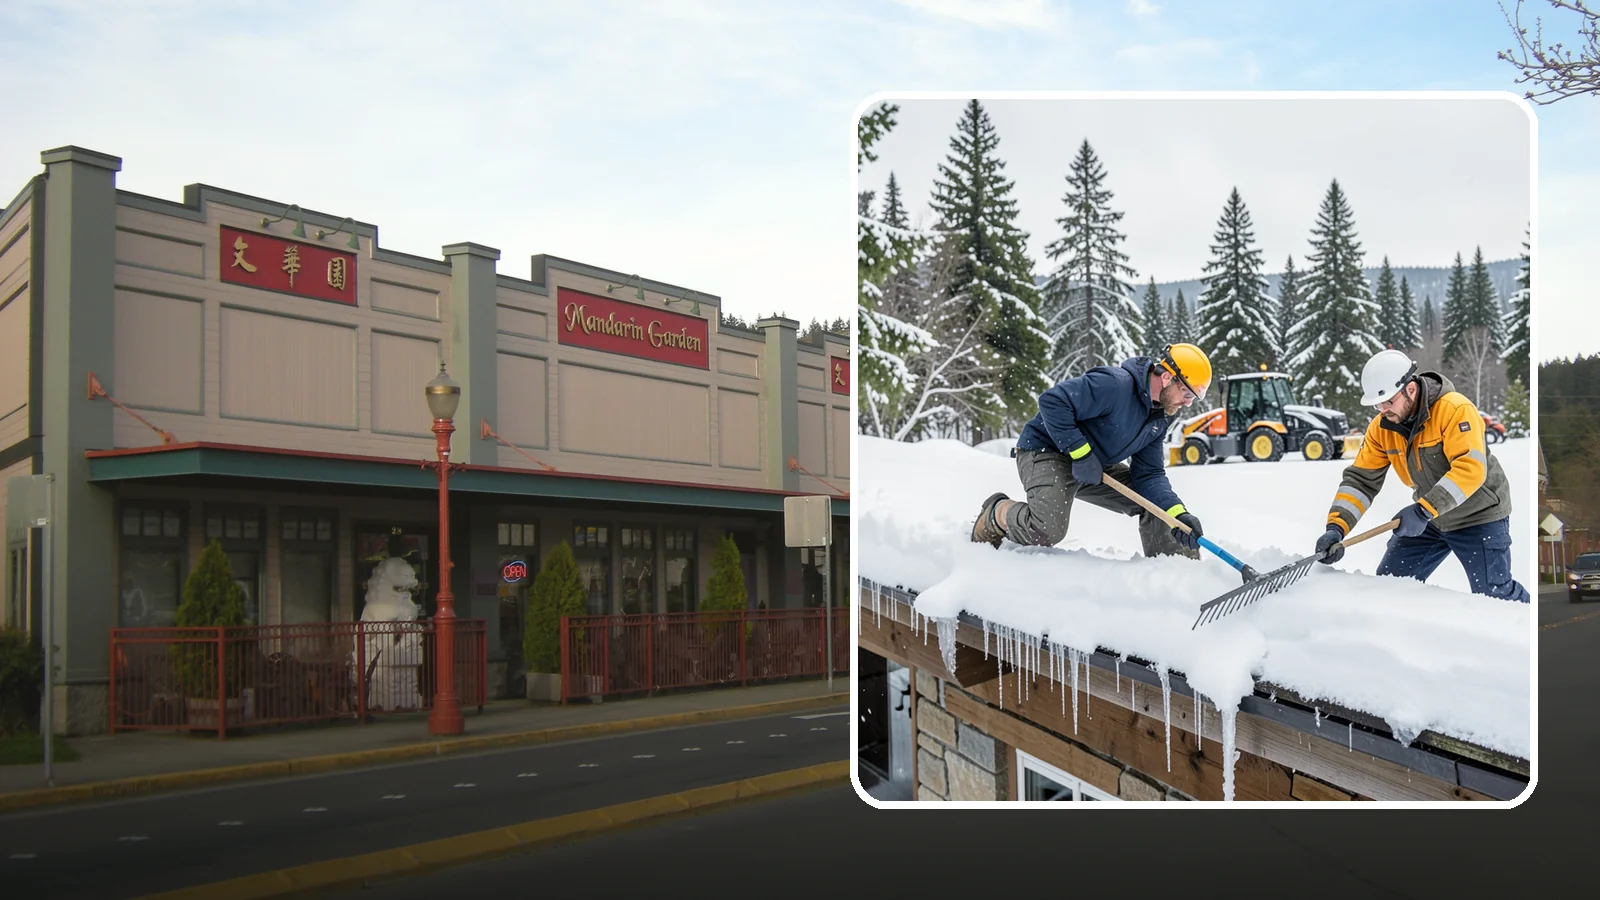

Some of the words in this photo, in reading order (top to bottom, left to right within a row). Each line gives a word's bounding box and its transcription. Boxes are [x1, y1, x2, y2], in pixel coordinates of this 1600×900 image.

[231, 236, 346, 291] 文華園
[564, 302, 644, 341] Mandarin
[648, 320, 702, 352] Garden
[835, 363, 846, 386] 文
[503, 565, 527, 578] OPEN
